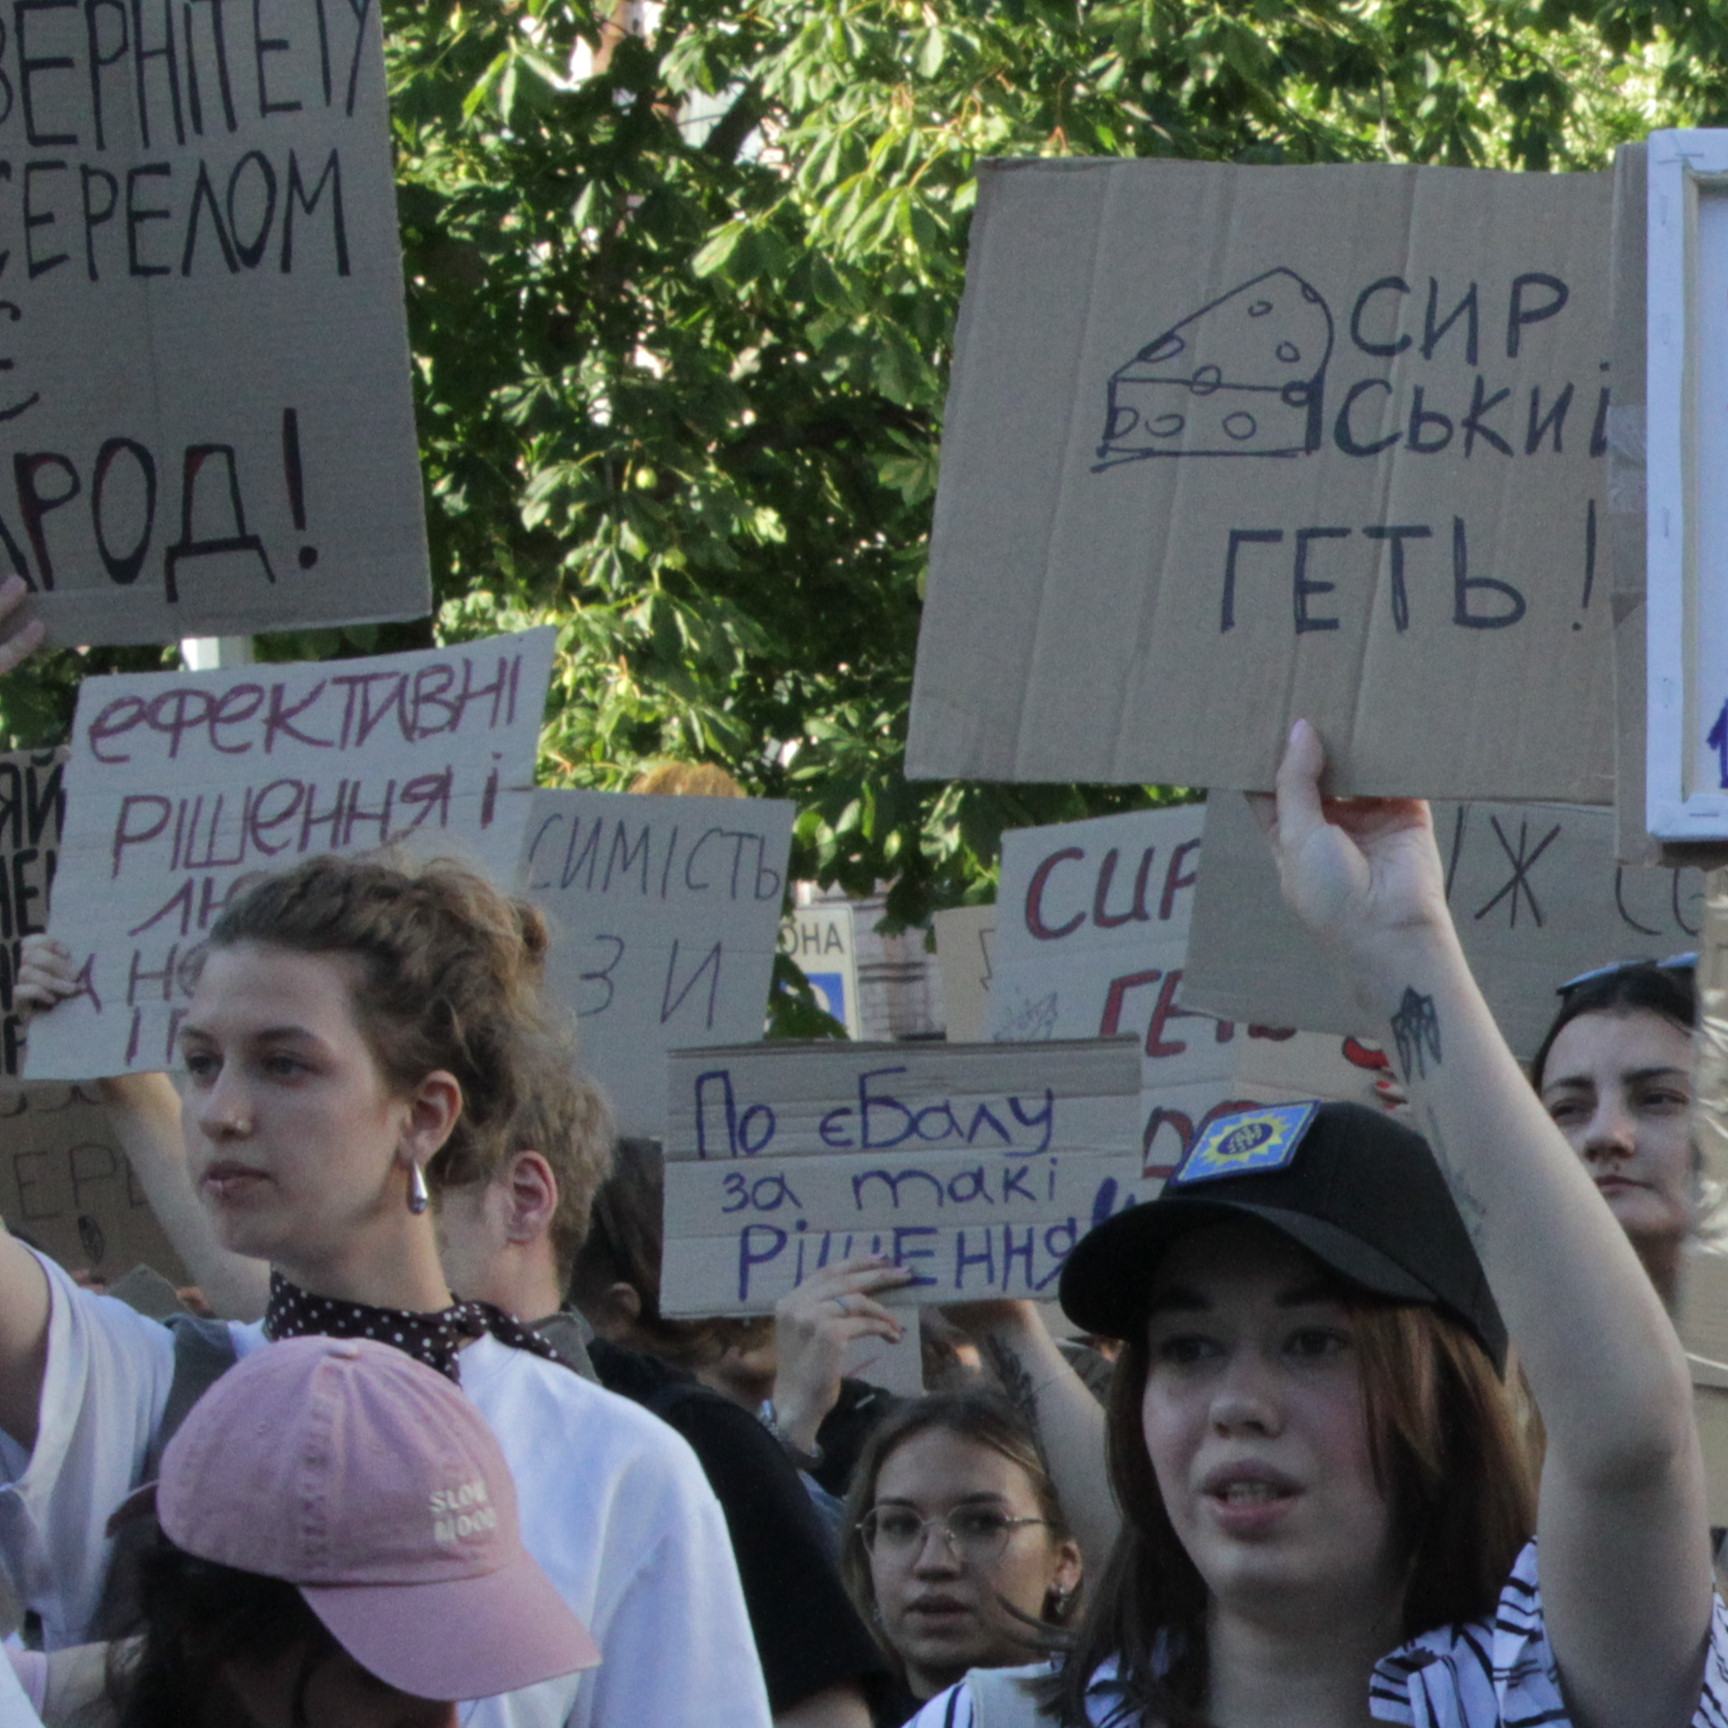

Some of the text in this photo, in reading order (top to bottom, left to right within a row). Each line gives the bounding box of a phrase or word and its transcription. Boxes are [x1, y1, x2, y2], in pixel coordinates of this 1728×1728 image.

[0, 148, 352, 284] ЕРЕЛОМ
[1349, 272, 1571, 366] СИР
[1219, 498, 1599, 636] ГЕТЬ!
[777, 921, 846, 957] ОНА
